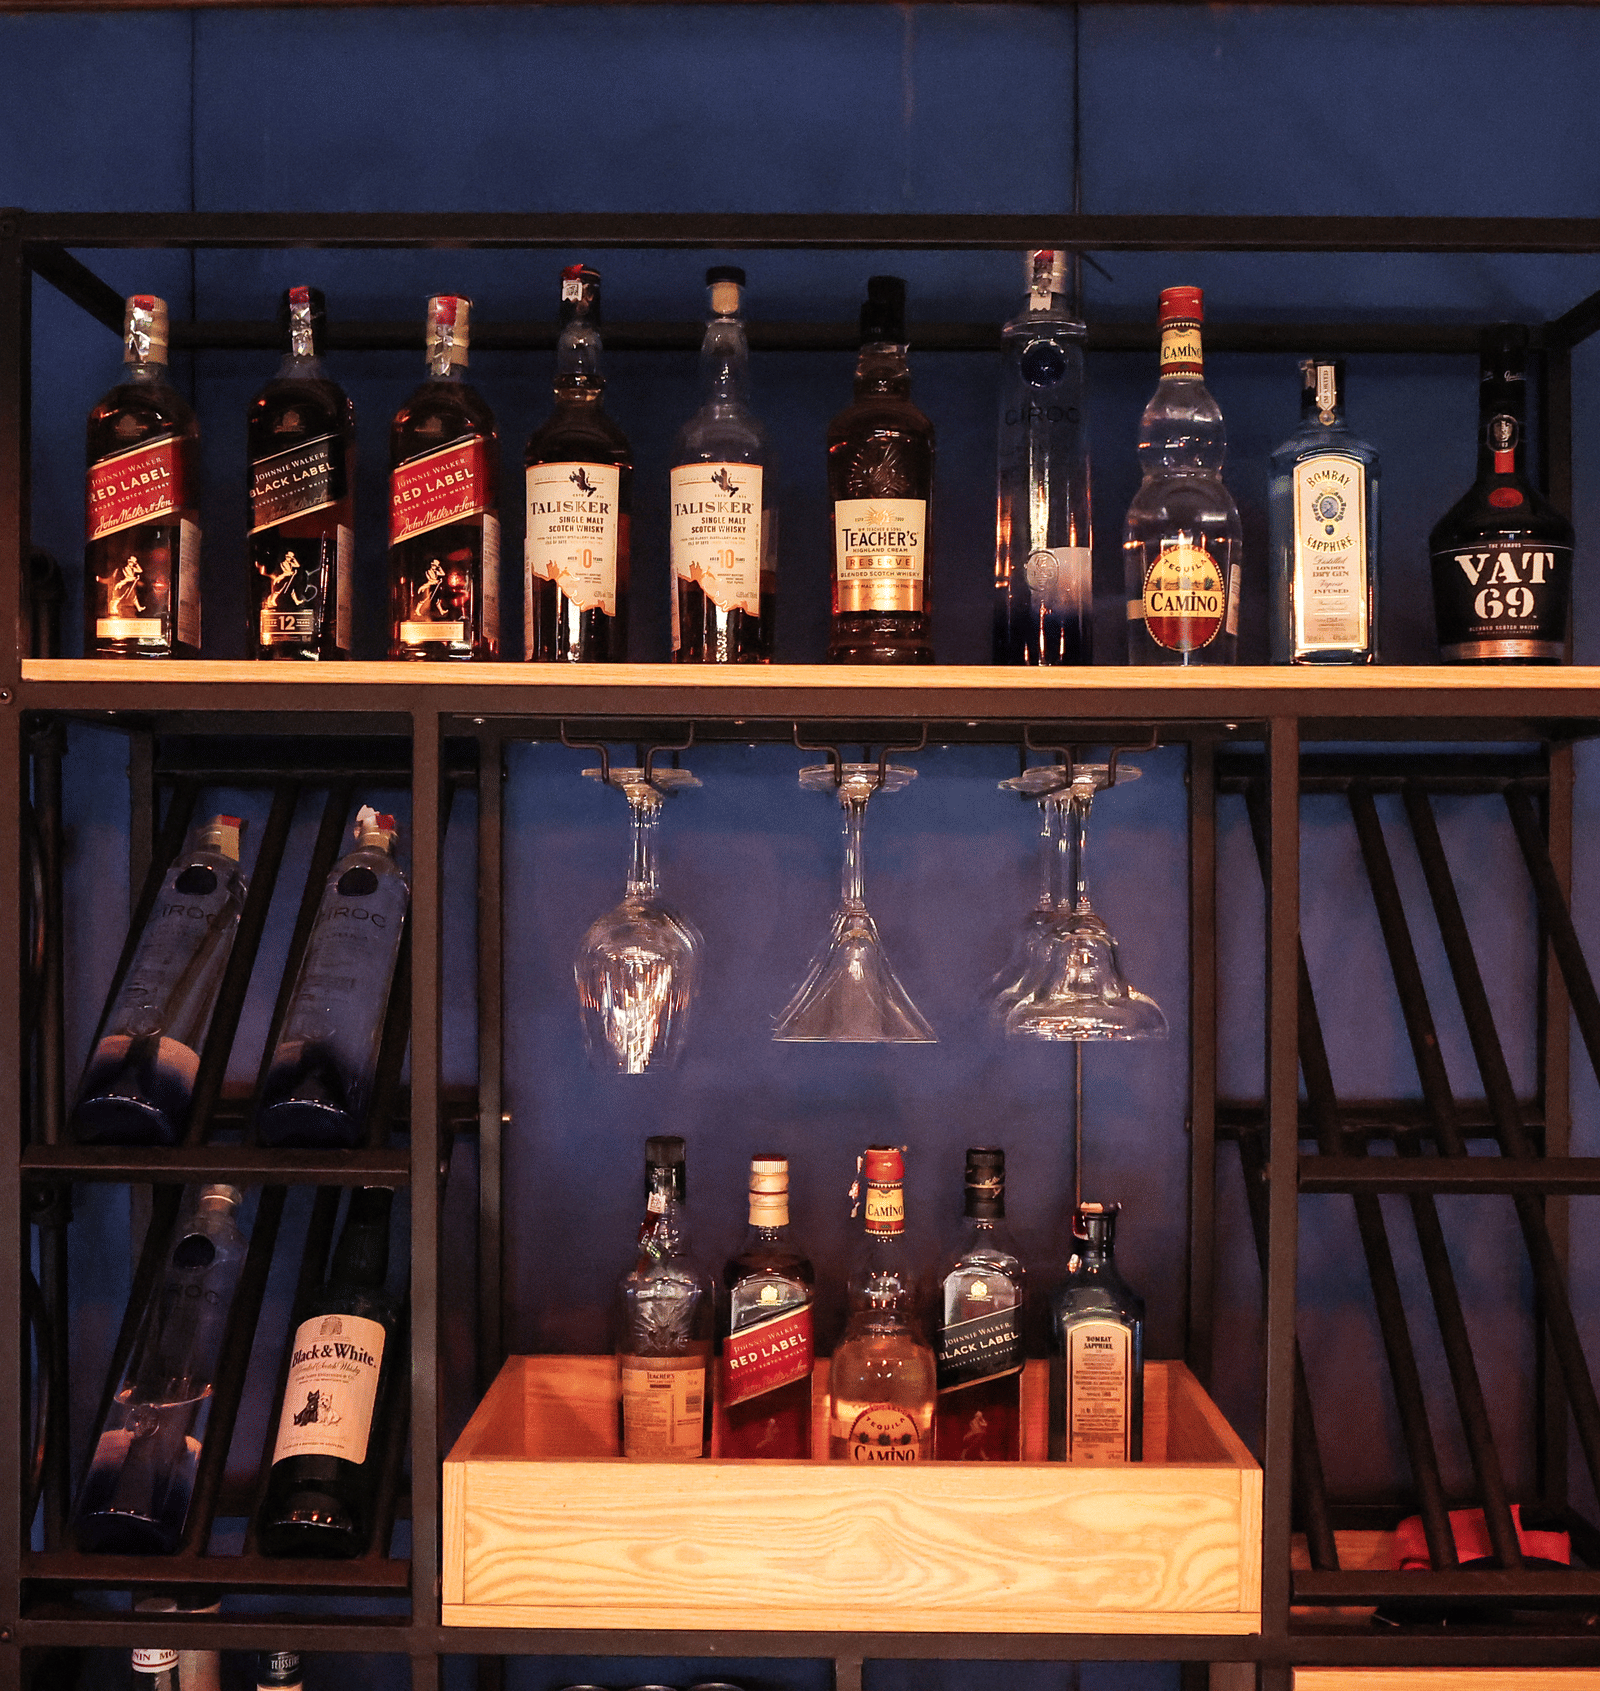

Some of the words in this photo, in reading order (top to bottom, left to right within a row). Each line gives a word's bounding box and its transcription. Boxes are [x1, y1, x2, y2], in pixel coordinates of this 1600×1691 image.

[255, 464, 291, 484] JOHNNIE
[291, 452, 325, 468] WALKER
[397, 471, 431, 490] JOHNNIE
[433, 458, 465, 474] WALKER
[121, 466, 171, 491] LABEL
[249, 476, 290, 498] BLACK
[293, 462, 335, 482] LABEL
[393, 487, 422, 506] RED
[425, 468, 474, 493] LABEL
[1306, 470, 1351, 488] BOMBAY
[530, 501, 609, 515] TALISKER
[674, 501, 752, 516] TALISKER
[548, 525, 574, 533] SCOTCH
[576, 525, 604, 534] WHISKY
[559, 516, 584, 524] SINGLE
[586, 517, 604, 525] MALT
[691, 525, 716, 534] SCOTCH
[719, 526, 747, 534] WHISKY
[701, 516, 726, 525] SINGLE
[728, 517, 746, 525] MALT
[842, 528, 919, 552] TEACHER'S
[1306, 534, 1354, 553] SAPPHIRE
[717, 548, 734, 569] 10
[850, 558, 911, 567] RESERVE
[1163, 559, 1207, 572] TEQUILA
[1454, 552, 1554, 586] VAT
[1474, 587, 1535, 619] 69
[279, 615, 296, 631] 12
[939, 1343, 977, 1360] BLACK
[979, 1331, 1019, 1349] LABEL
[944, 1331, 977, 1349] JOHNNIE
[730, 1352, 758, 1370] RED
[761, 1333, 807, 1357] LABEL
